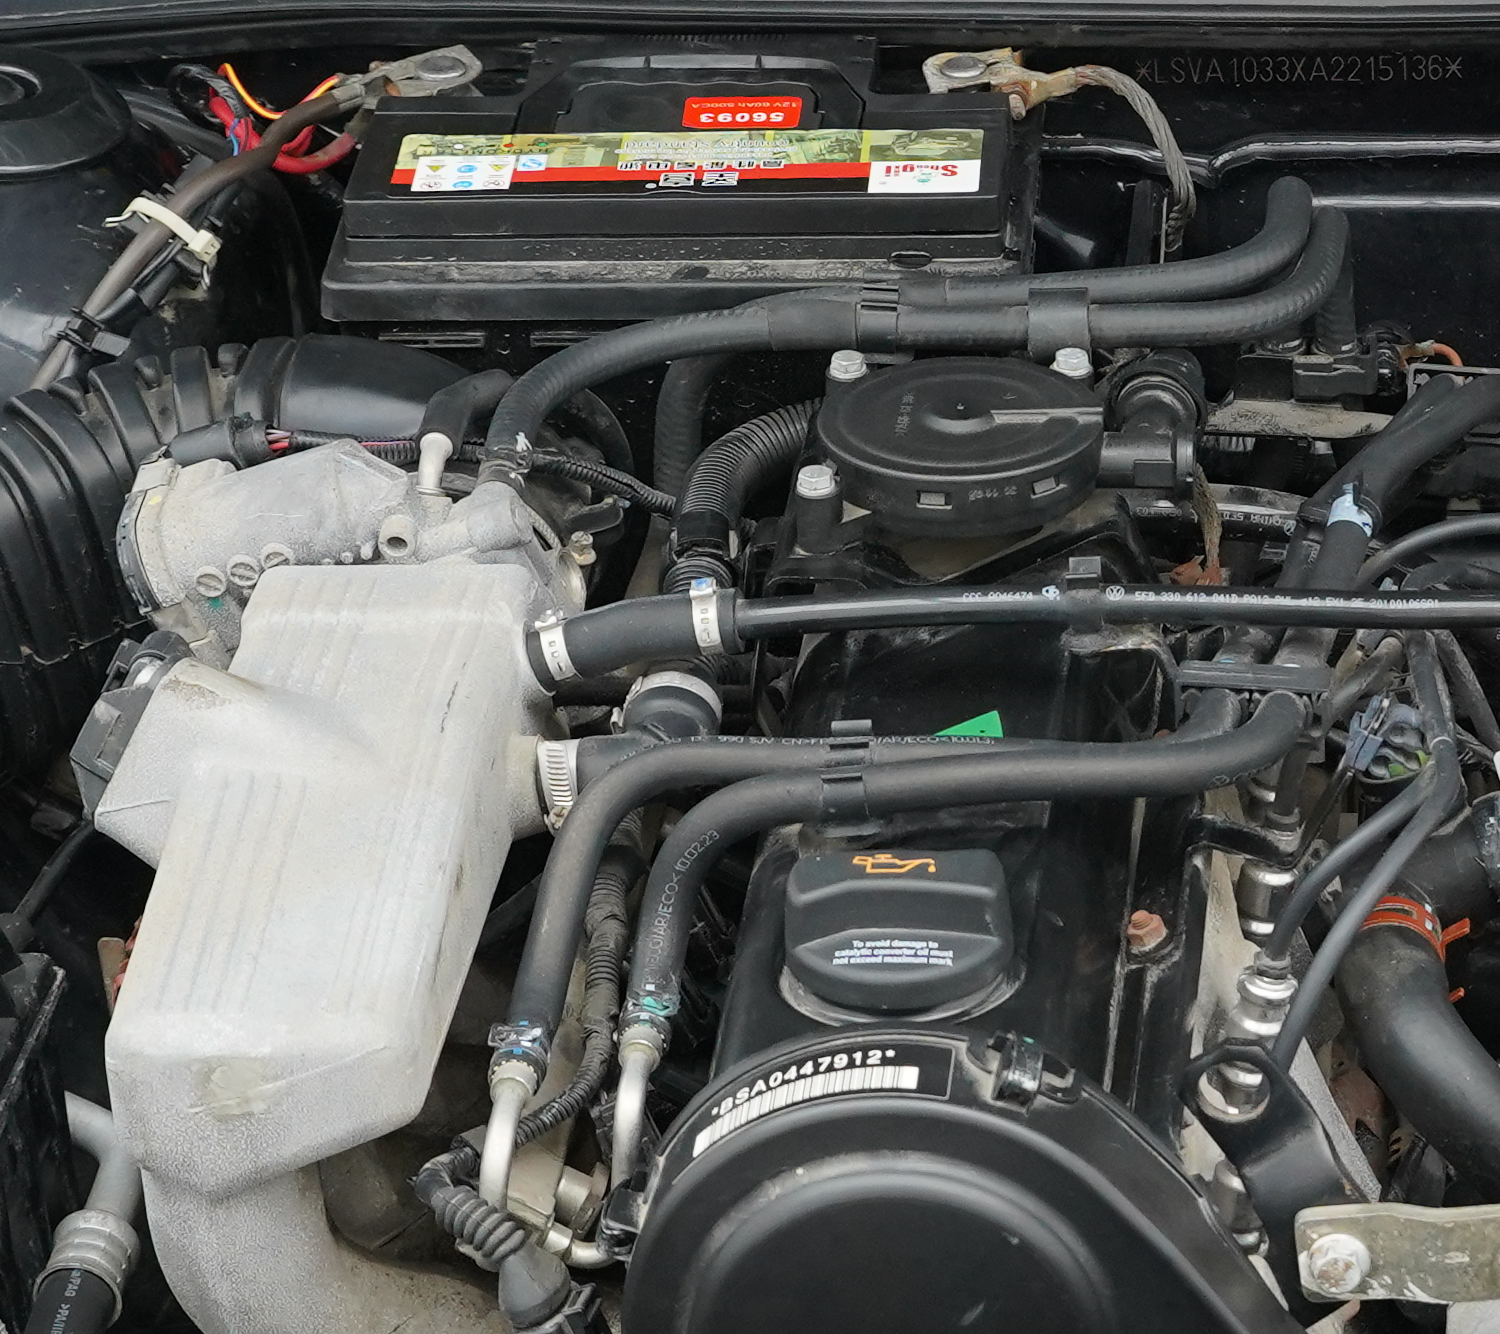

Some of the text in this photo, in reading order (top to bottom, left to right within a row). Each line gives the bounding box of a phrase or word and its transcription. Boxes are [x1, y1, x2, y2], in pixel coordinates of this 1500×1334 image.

[699, 111, 785, 123] 56093
[1161, 591, 1181, 601] 330
[1186, 590, 1206, 601] 612
[852, 938, 939, 950] To avoid damage to
[834, 948, 954, 958] catalytic converter oil must
[832, 956, 954, 967] not exceed maximum mark
